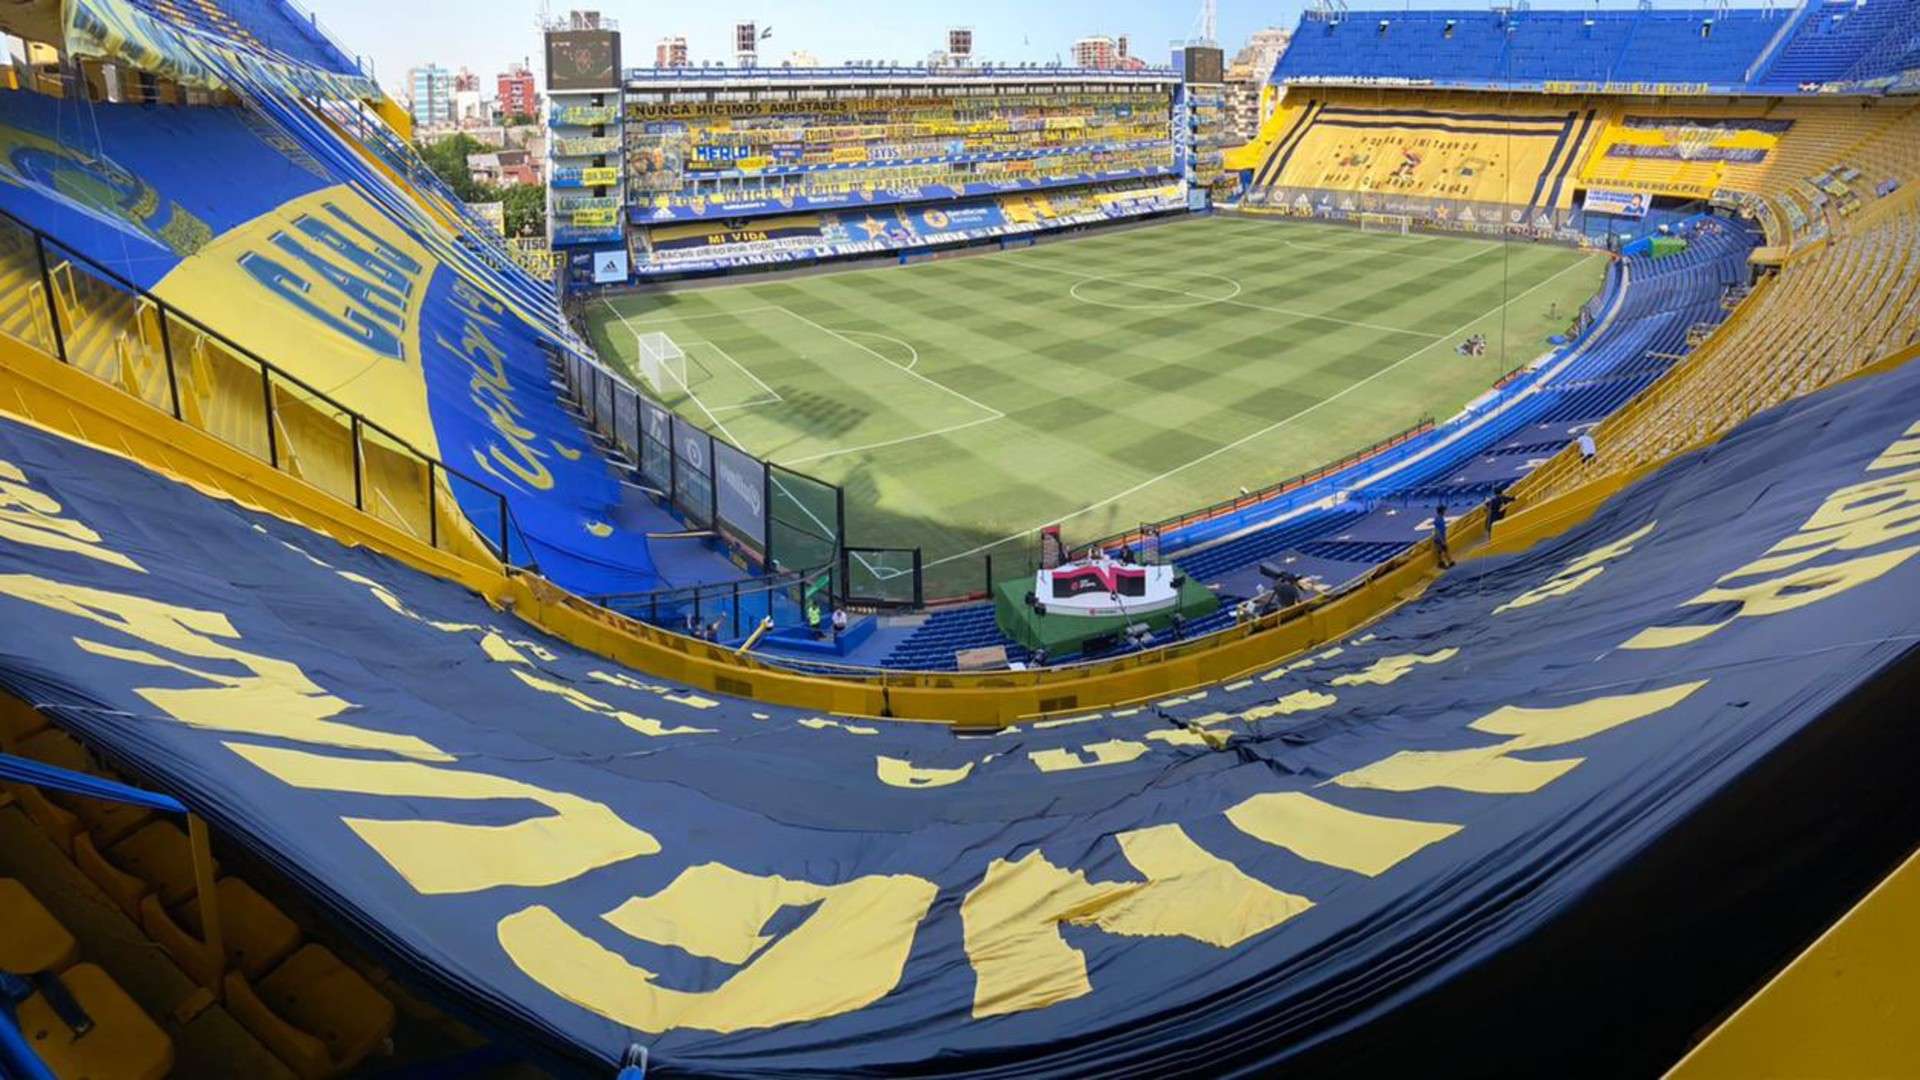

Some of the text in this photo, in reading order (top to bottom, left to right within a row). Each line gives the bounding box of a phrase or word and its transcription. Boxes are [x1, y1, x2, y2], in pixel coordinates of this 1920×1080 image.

[635, 104, 690, 116] NUNCA
[697, 103, 762, 115] HICIMOS
[770, 101, 847, 113] AMISTADES
[707, 232, 768, 245] MI VIDA
[237, 202, 423, 362] CABJ
